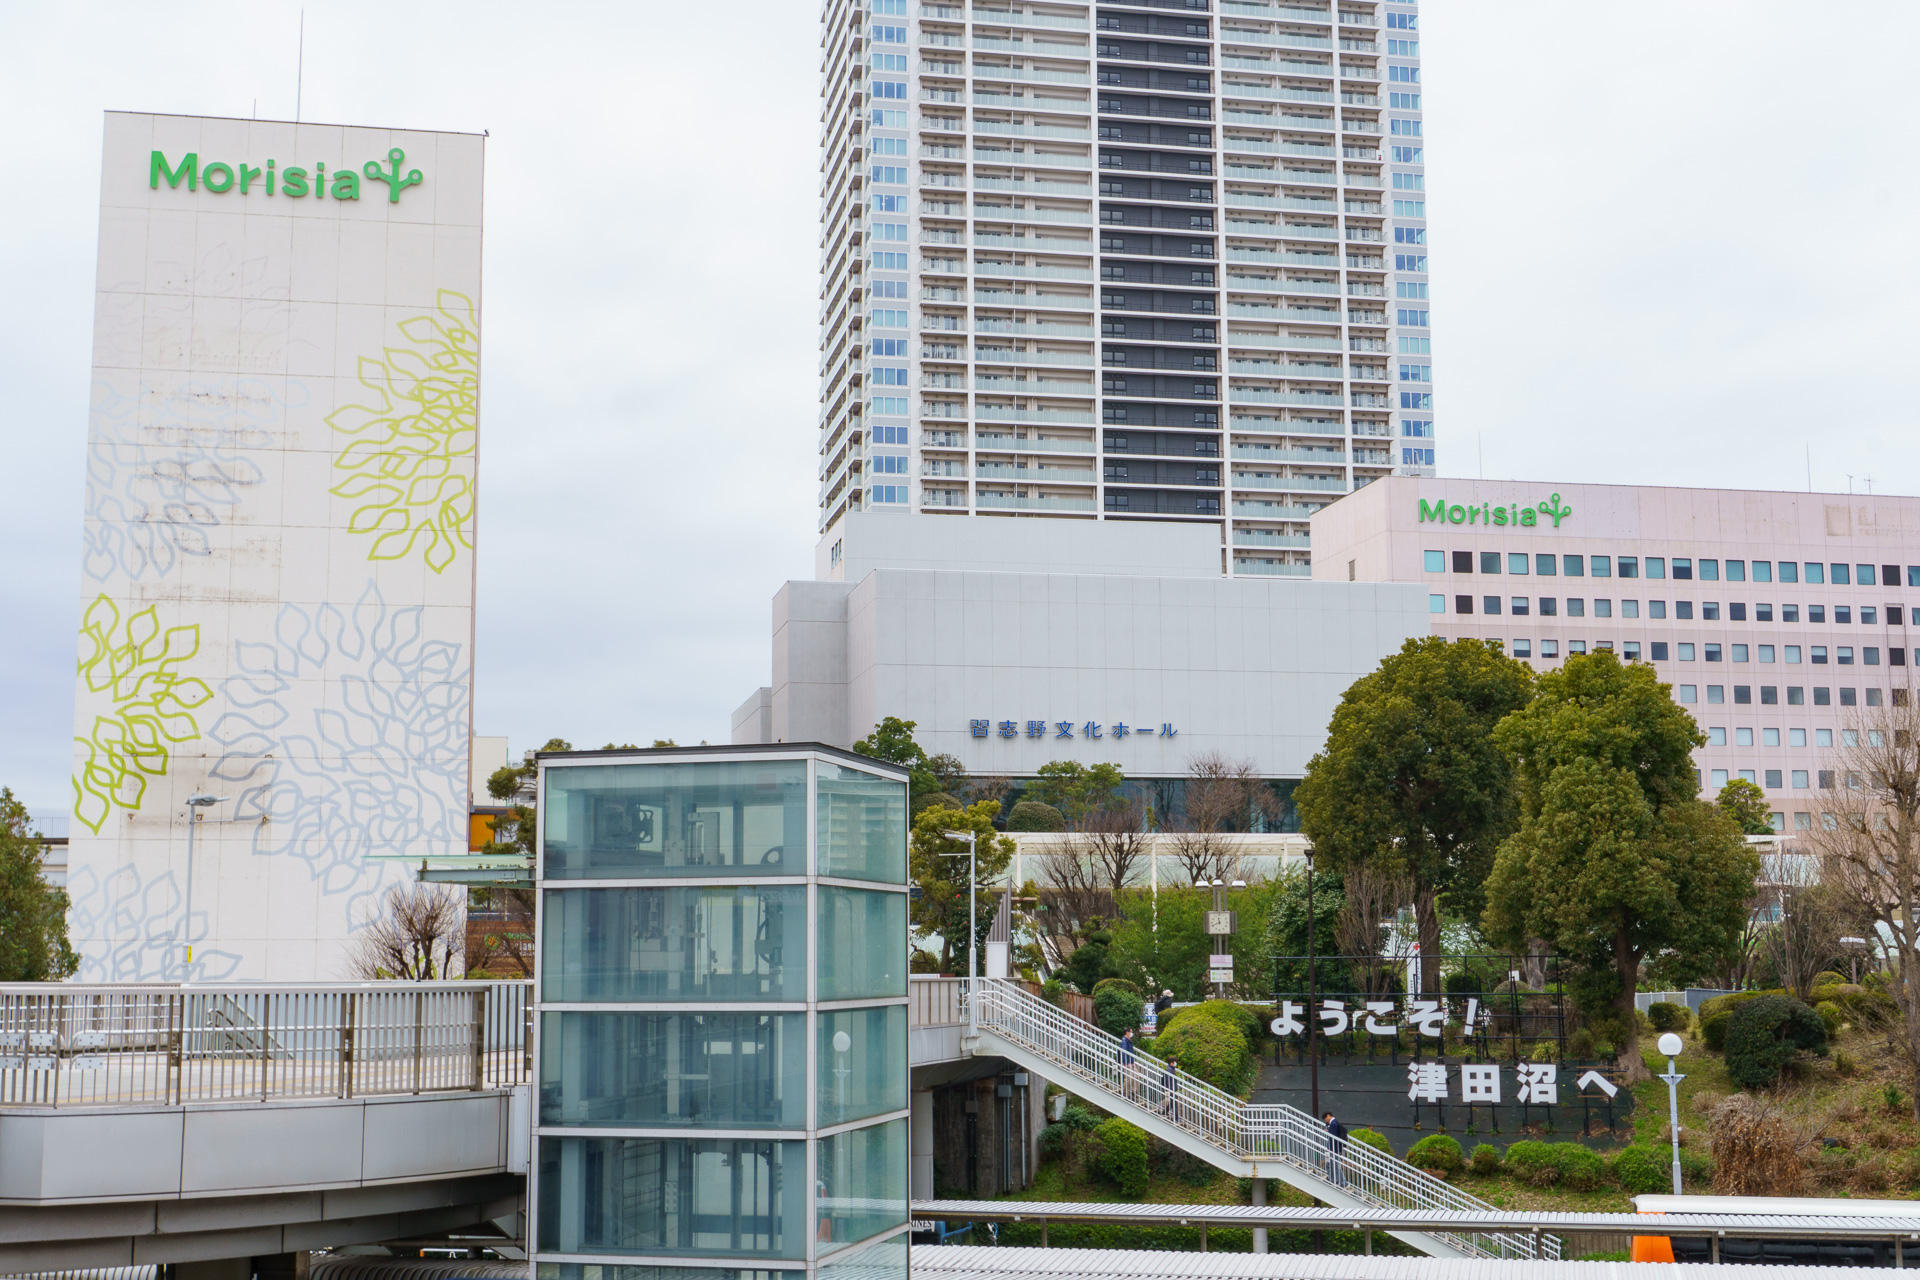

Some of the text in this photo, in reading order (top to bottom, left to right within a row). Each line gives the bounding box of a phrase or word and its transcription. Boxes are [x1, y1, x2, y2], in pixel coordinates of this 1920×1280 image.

[150, 150, 360, 201] Morisia
[1419, 498, 1537, 527] Morisia
[969, 718, 1179, 739] 習志野文化ホール
[1407, 1061, 1618, 1104] 津田沼へ
